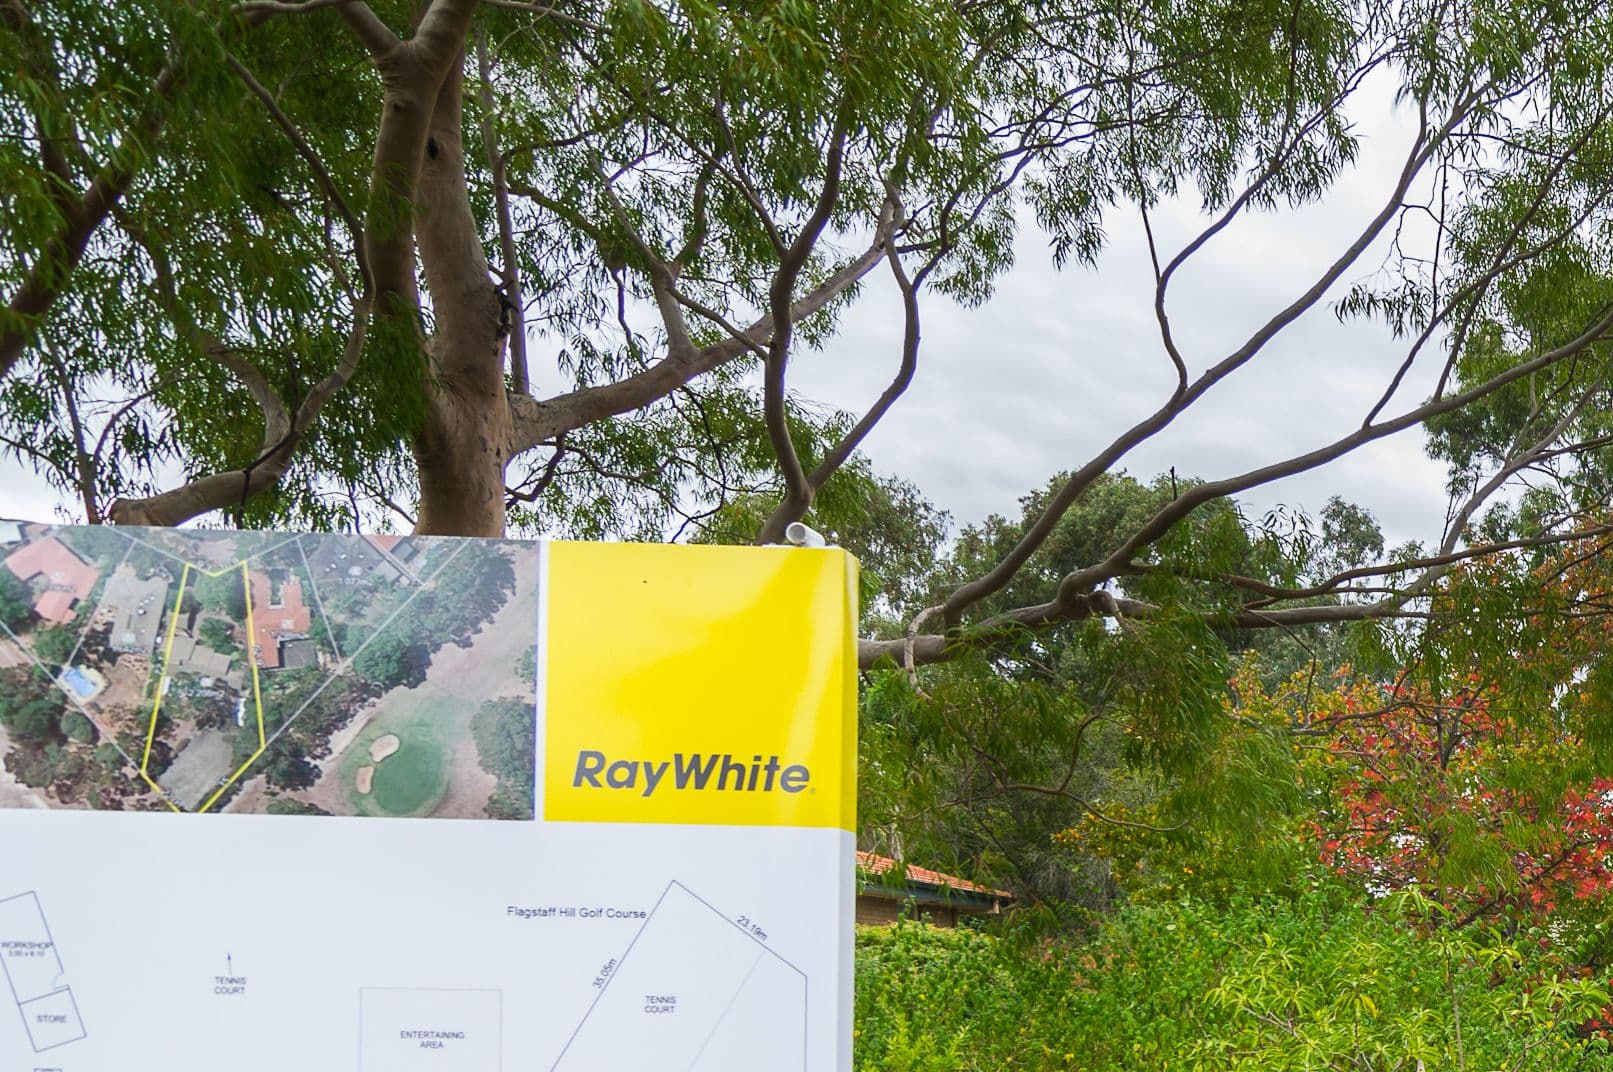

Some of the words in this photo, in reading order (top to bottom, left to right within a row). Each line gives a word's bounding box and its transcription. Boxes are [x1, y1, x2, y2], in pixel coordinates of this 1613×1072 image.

[507, 906, 556, 918] Flagstaff
[559, 907, 575, 917] Hill
[580, 908, 603, 918] Golf
[606, 908, 646, 919] Course
[736, 915, 768, 941] 23.19m
[592, 957, 617, 989] 35.05m
[215, 976, 246, 985] TENNIS
[214, 986, 245, 995] COURT
[645, 995, 676, 1004] TENNIS
[644, 1005, 675, 1014] COURT
[400, 1030, 465, 1040] ENTERTAINING
[420, 1041, 444, 1049] AREA
